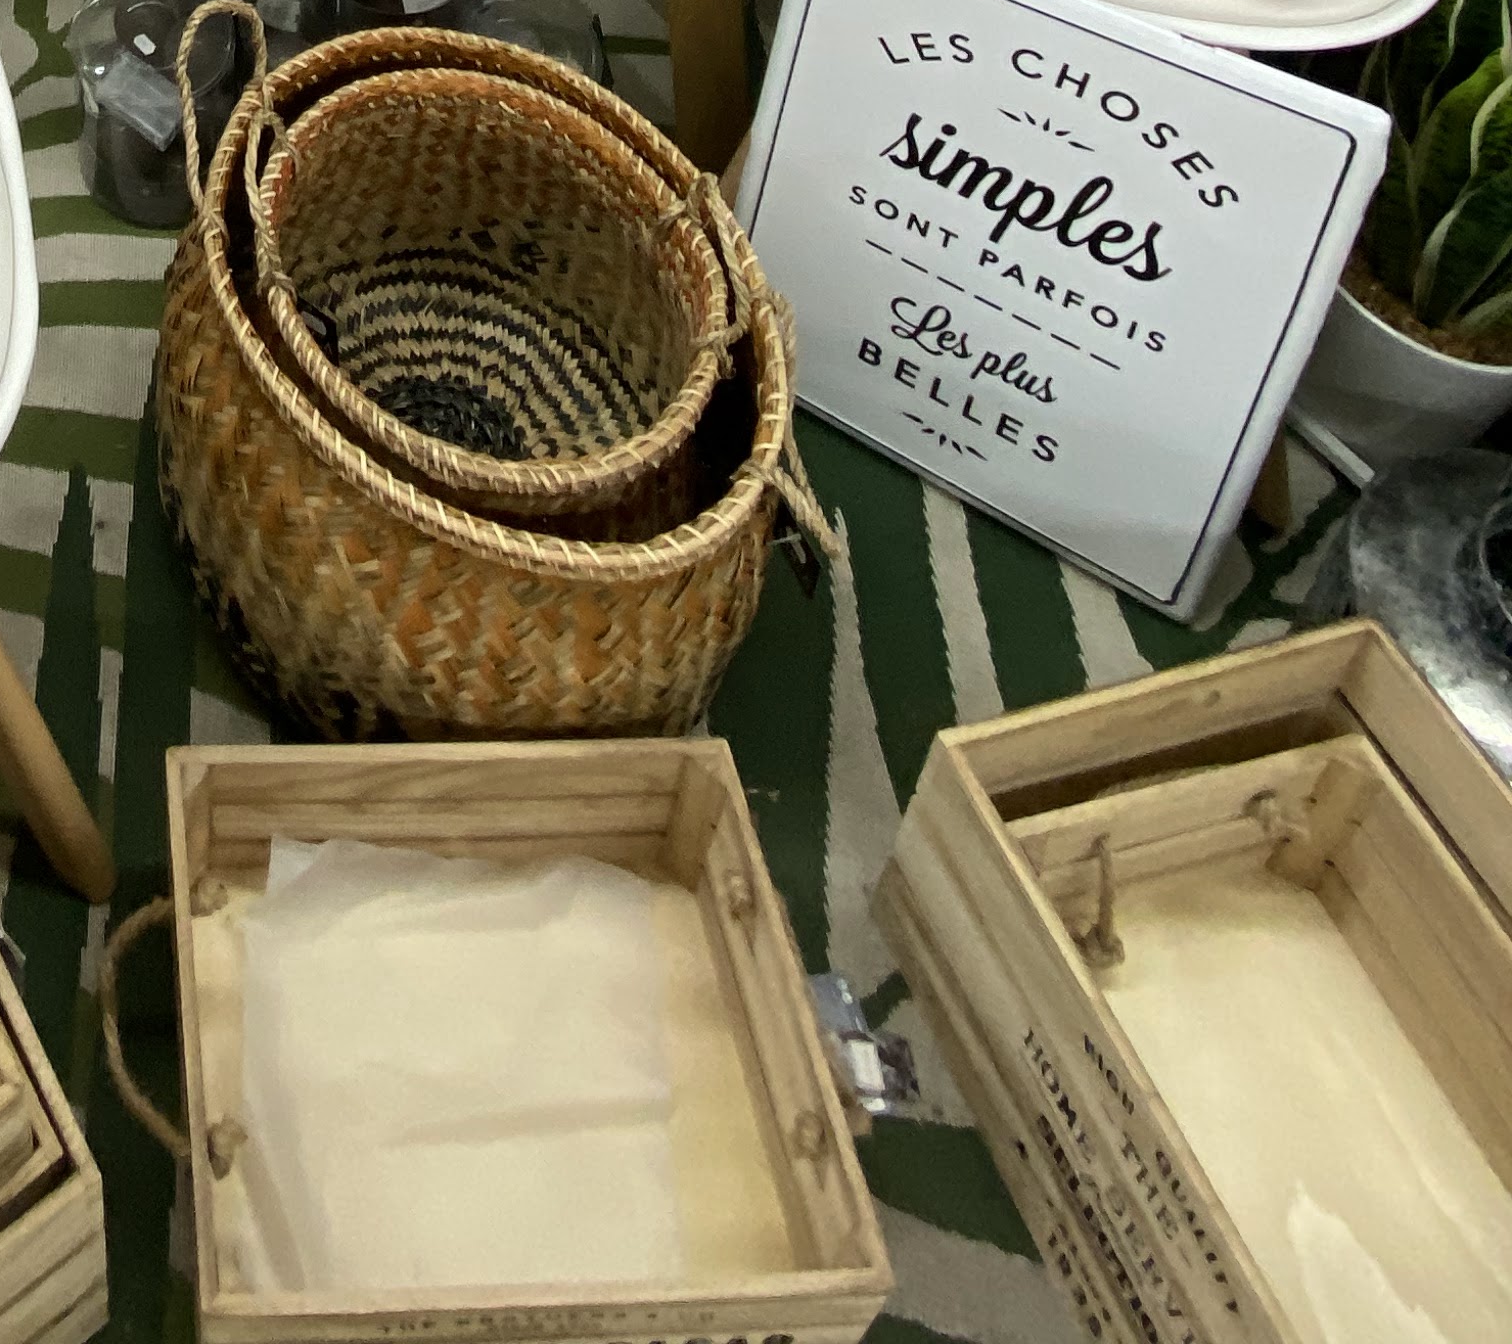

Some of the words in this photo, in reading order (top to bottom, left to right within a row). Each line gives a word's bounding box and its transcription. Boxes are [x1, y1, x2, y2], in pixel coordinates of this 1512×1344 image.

[878, 33, 974, 65] LES
[1011, 48, 1239, 208] CHOSES
[879, 112, 1172, 282] simples
[848, 185, 959, 248] SONT
[978, 248, 1166, 352] PARFOIS
[858, 336, 1059, 462] BELLES
[890, 296, 973, 359] Les
[971, 351, 1057, 404] plus
[1023, 1026, 1095, 1164] HOME
[1121, 1130, 1180, 1241] THE
